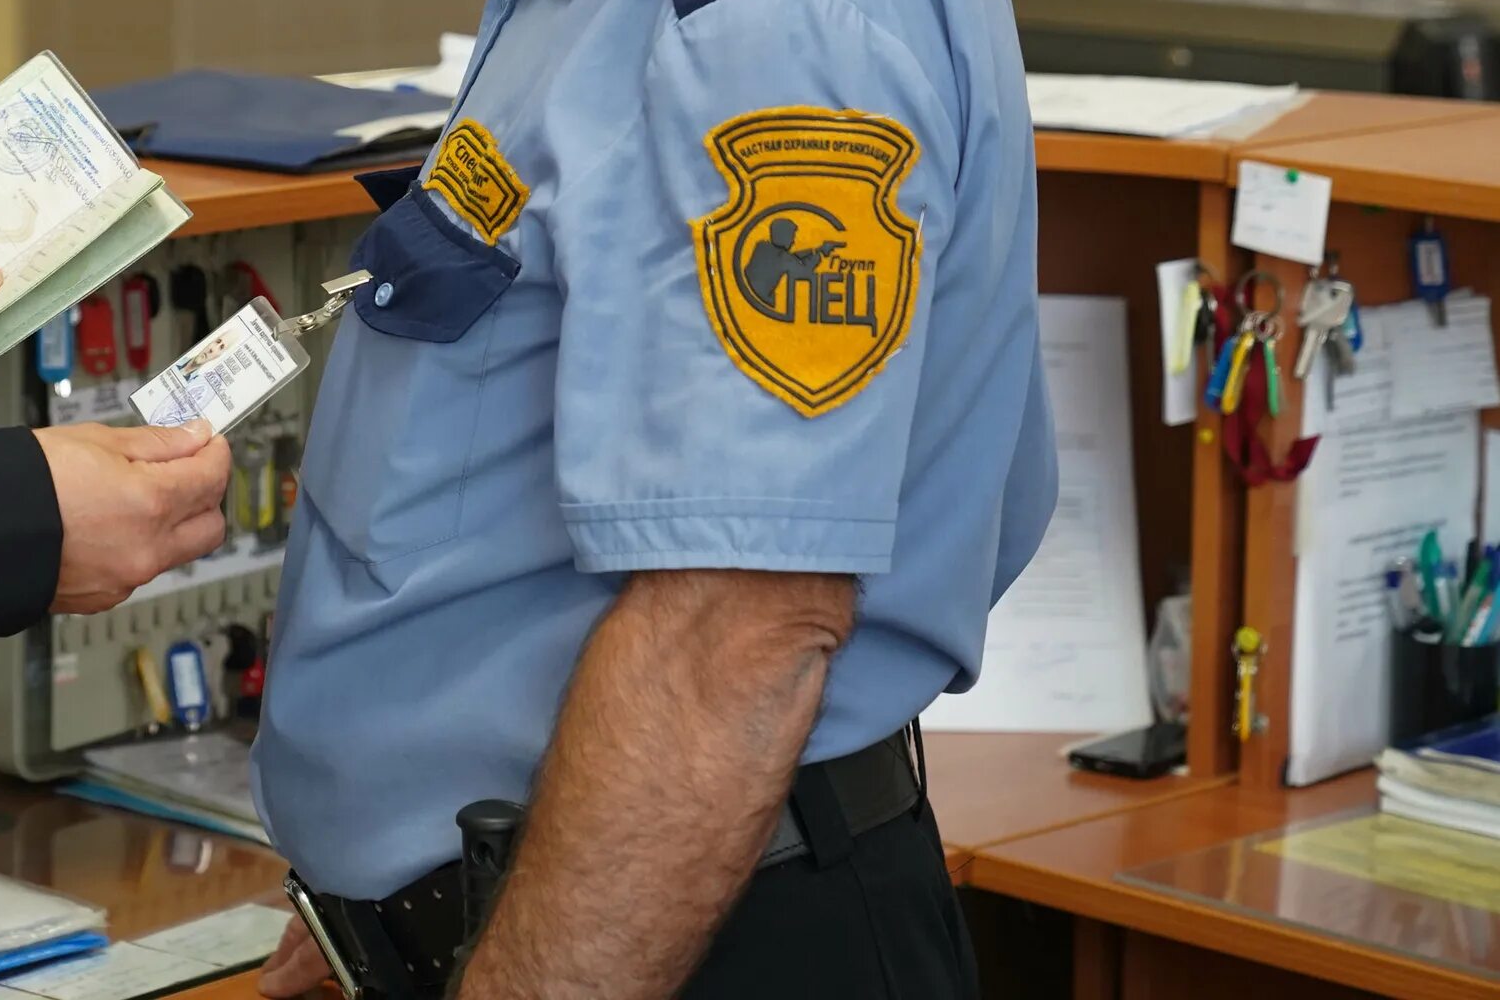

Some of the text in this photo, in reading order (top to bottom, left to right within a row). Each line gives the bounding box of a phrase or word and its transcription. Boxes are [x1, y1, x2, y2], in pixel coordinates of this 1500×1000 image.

[740, 140, 782, 158] ЧАСТНАЯ
[785, 139, 830, 151] ОХРАННАЯ
[829, 254, 876, 273] Групп
